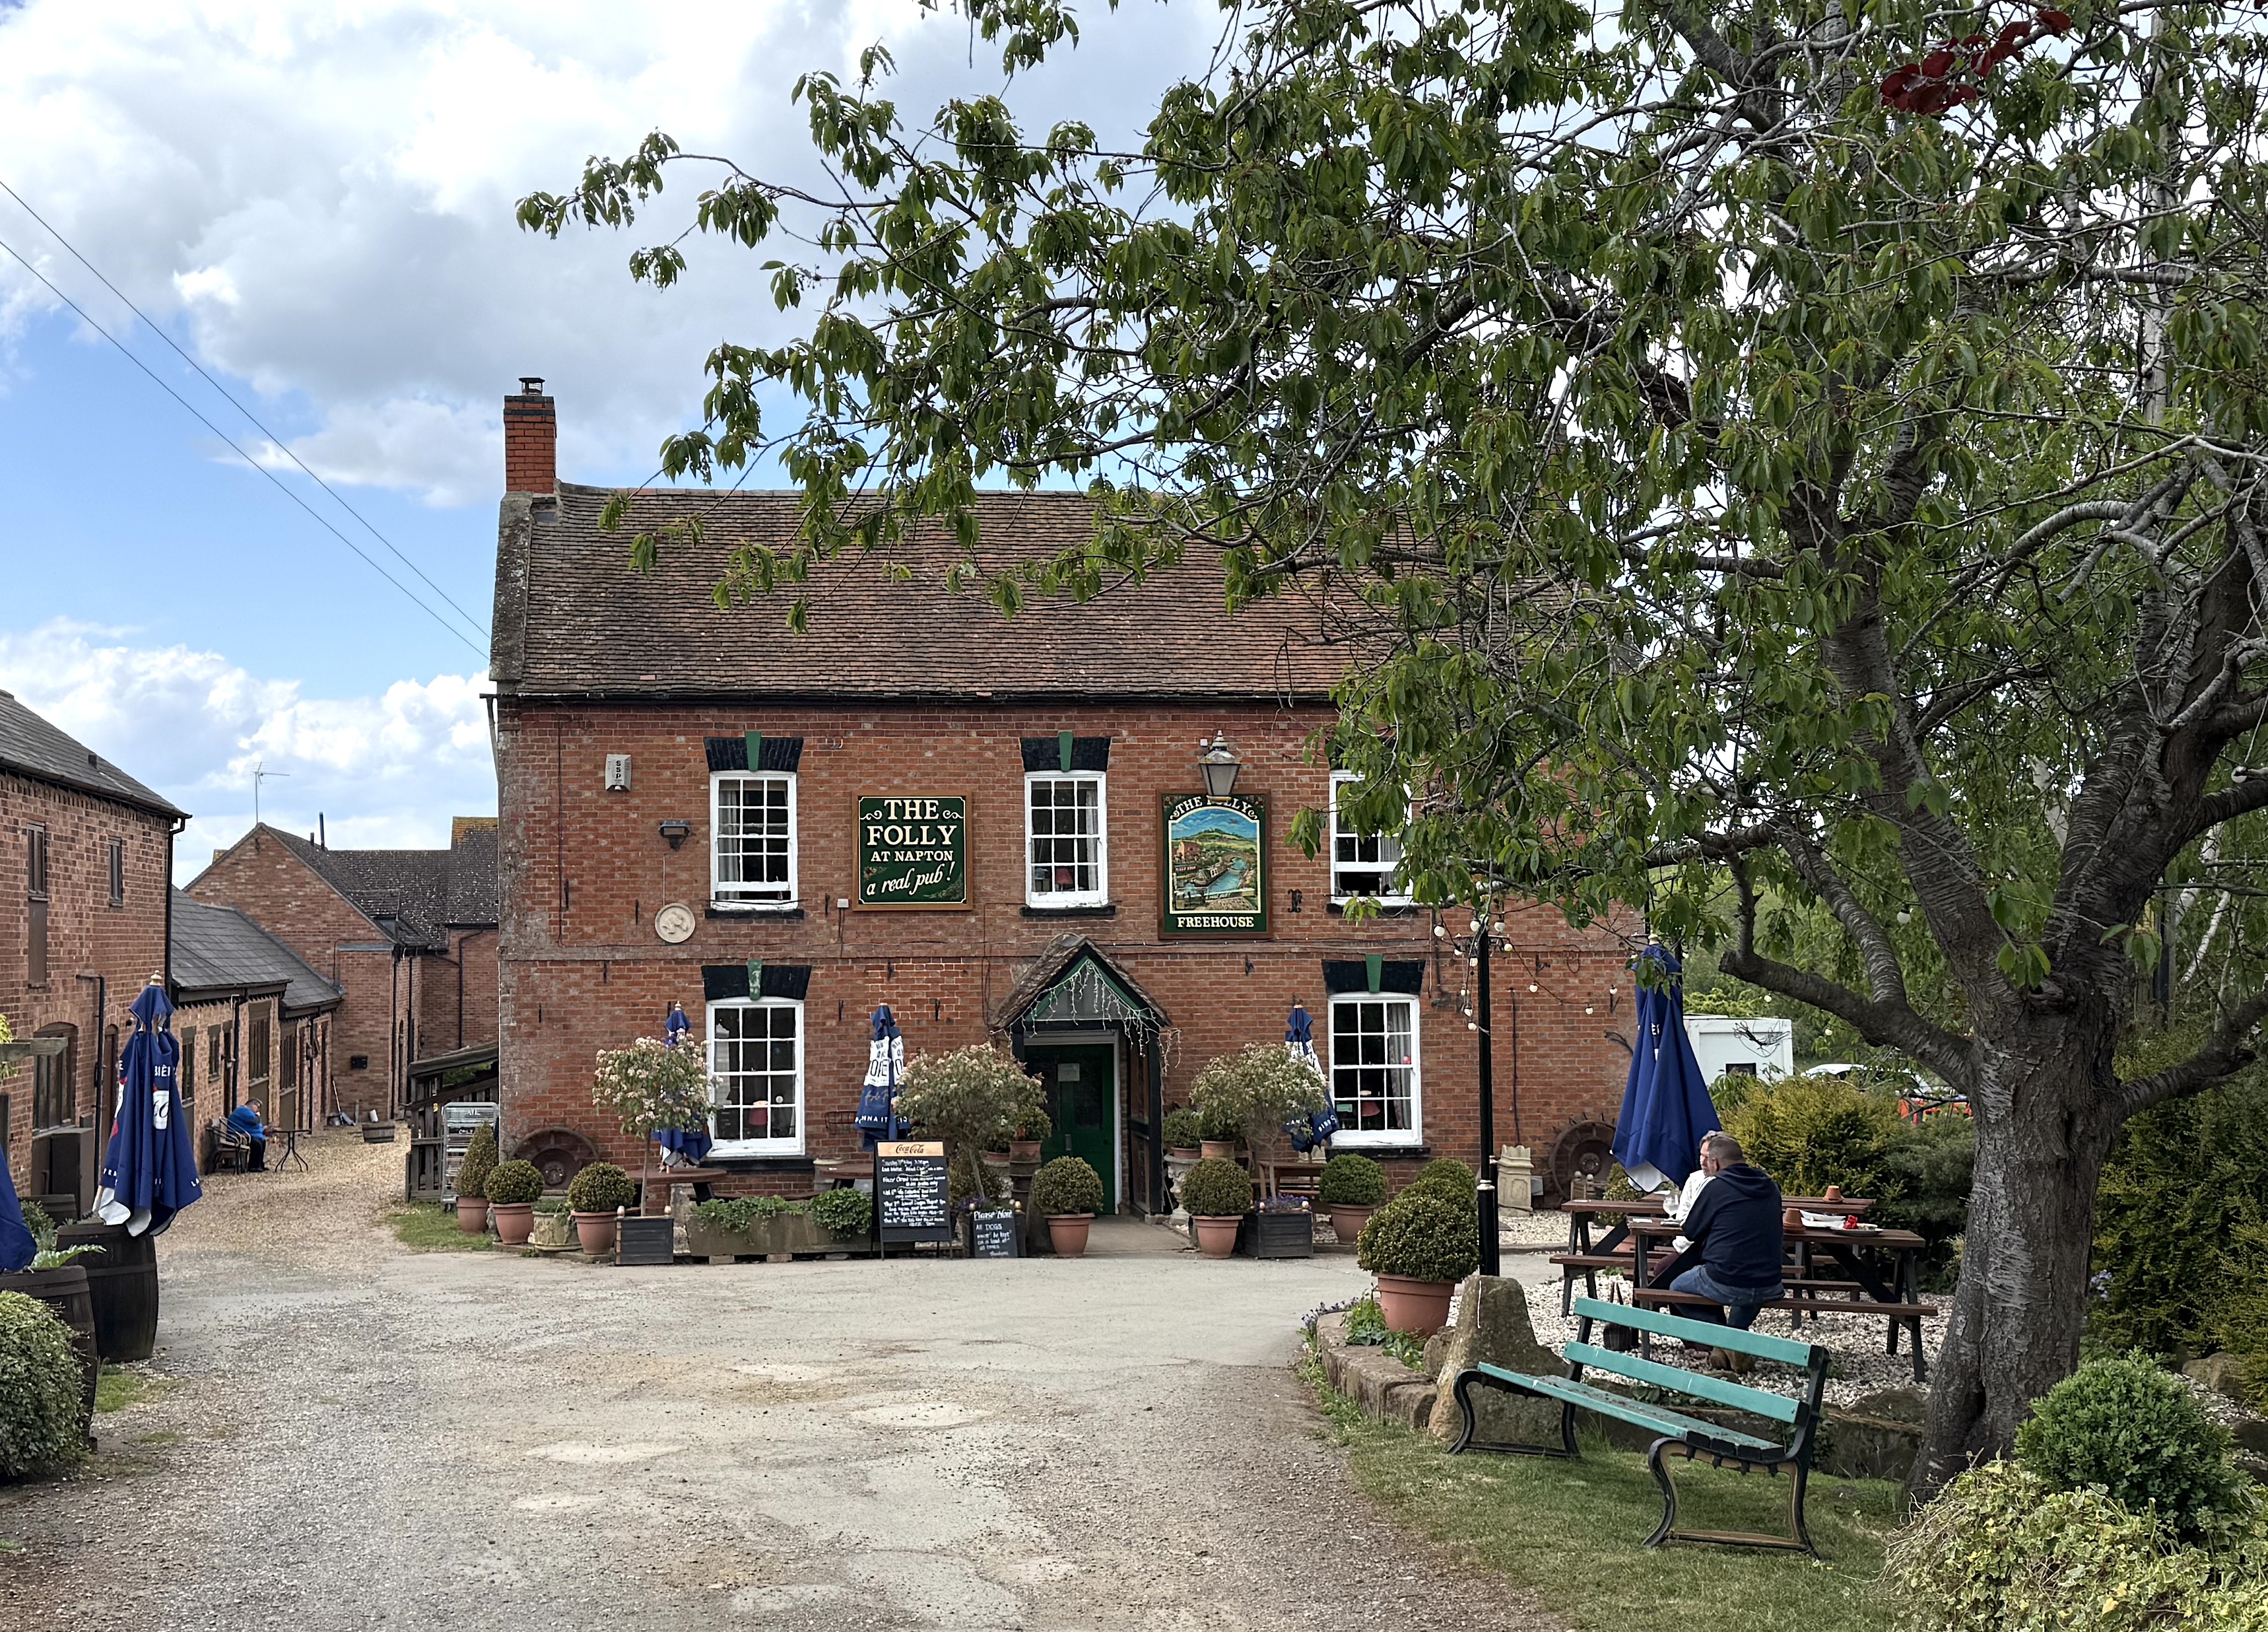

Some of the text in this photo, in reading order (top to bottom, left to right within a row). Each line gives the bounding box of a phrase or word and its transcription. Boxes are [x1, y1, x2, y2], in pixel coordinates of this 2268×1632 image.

[884, 799, 939, 820] THE
[1176, 796, 1203, 814] THE
[867, 825, 957, 846] FOLLY
[871, 850, 954, 862] AT NAPTON
[867, 883, 876, 895] a
[881, 867, 915, 893] real
[1177, 916, 1254, 928] FREEHOUSE
